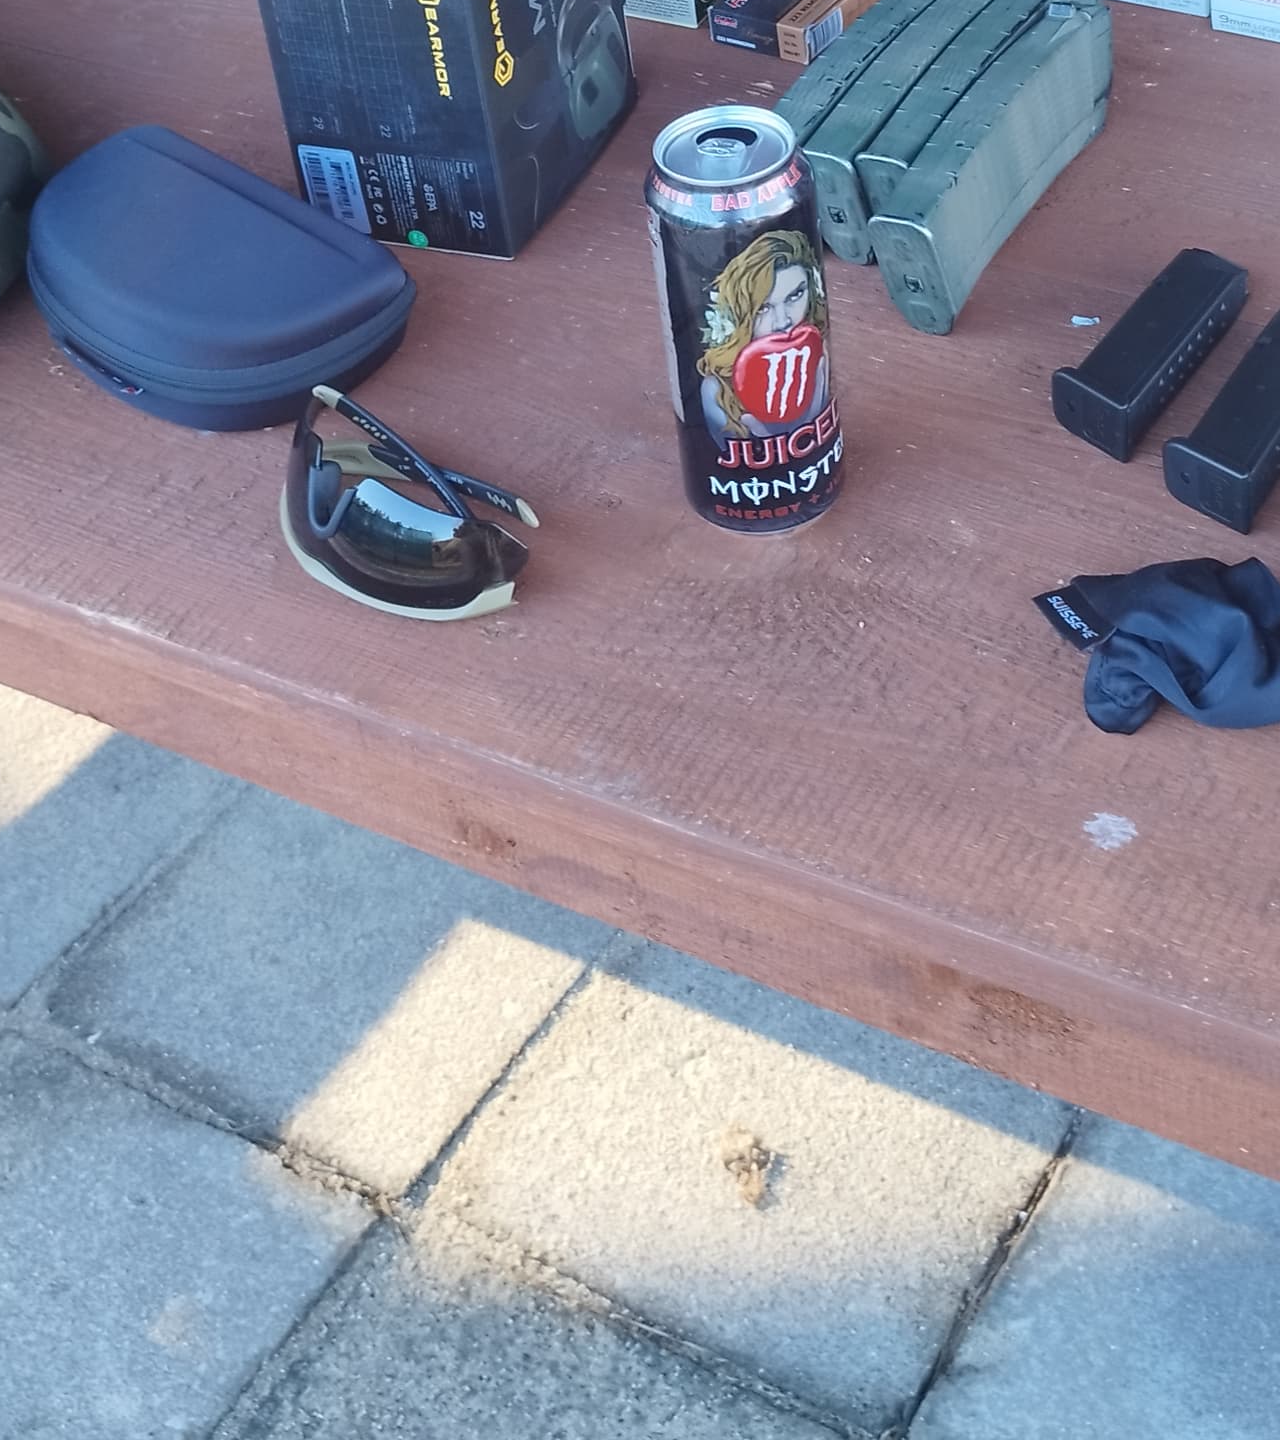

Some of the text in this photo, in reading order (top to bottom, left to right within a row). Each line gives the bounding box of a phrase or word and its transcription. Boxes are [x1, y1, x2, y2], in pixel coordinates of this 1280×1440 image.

[1218, 14, 1251, 28] 9mm
[424, 6, 451, 98] EARMOR
[711, 191, 752, 212] BAD
[470, 210, 486, 230] 22
[709, 427, 844, 506] MONSTE
[715, 502, 801, 520] ENERGY
